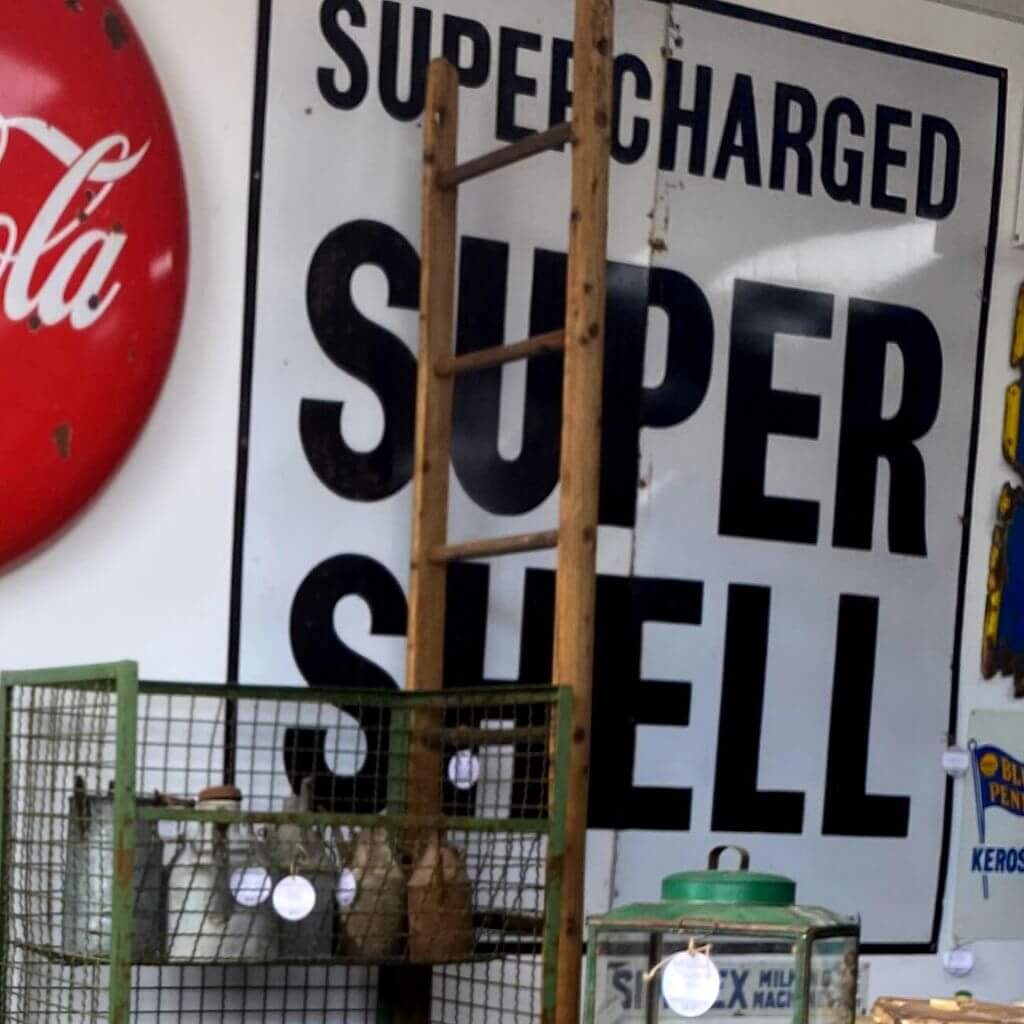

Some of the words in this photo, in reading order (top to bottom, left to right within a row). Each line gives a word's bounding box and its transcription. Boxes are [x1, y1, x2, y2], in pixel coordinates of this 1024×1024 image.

[299, 219, 943, 558] SUPER
[283, 552, 912, 838] SHELL
[1001, 756, 1024, 786] BL
[989, 781, 1024, 813] PEN
